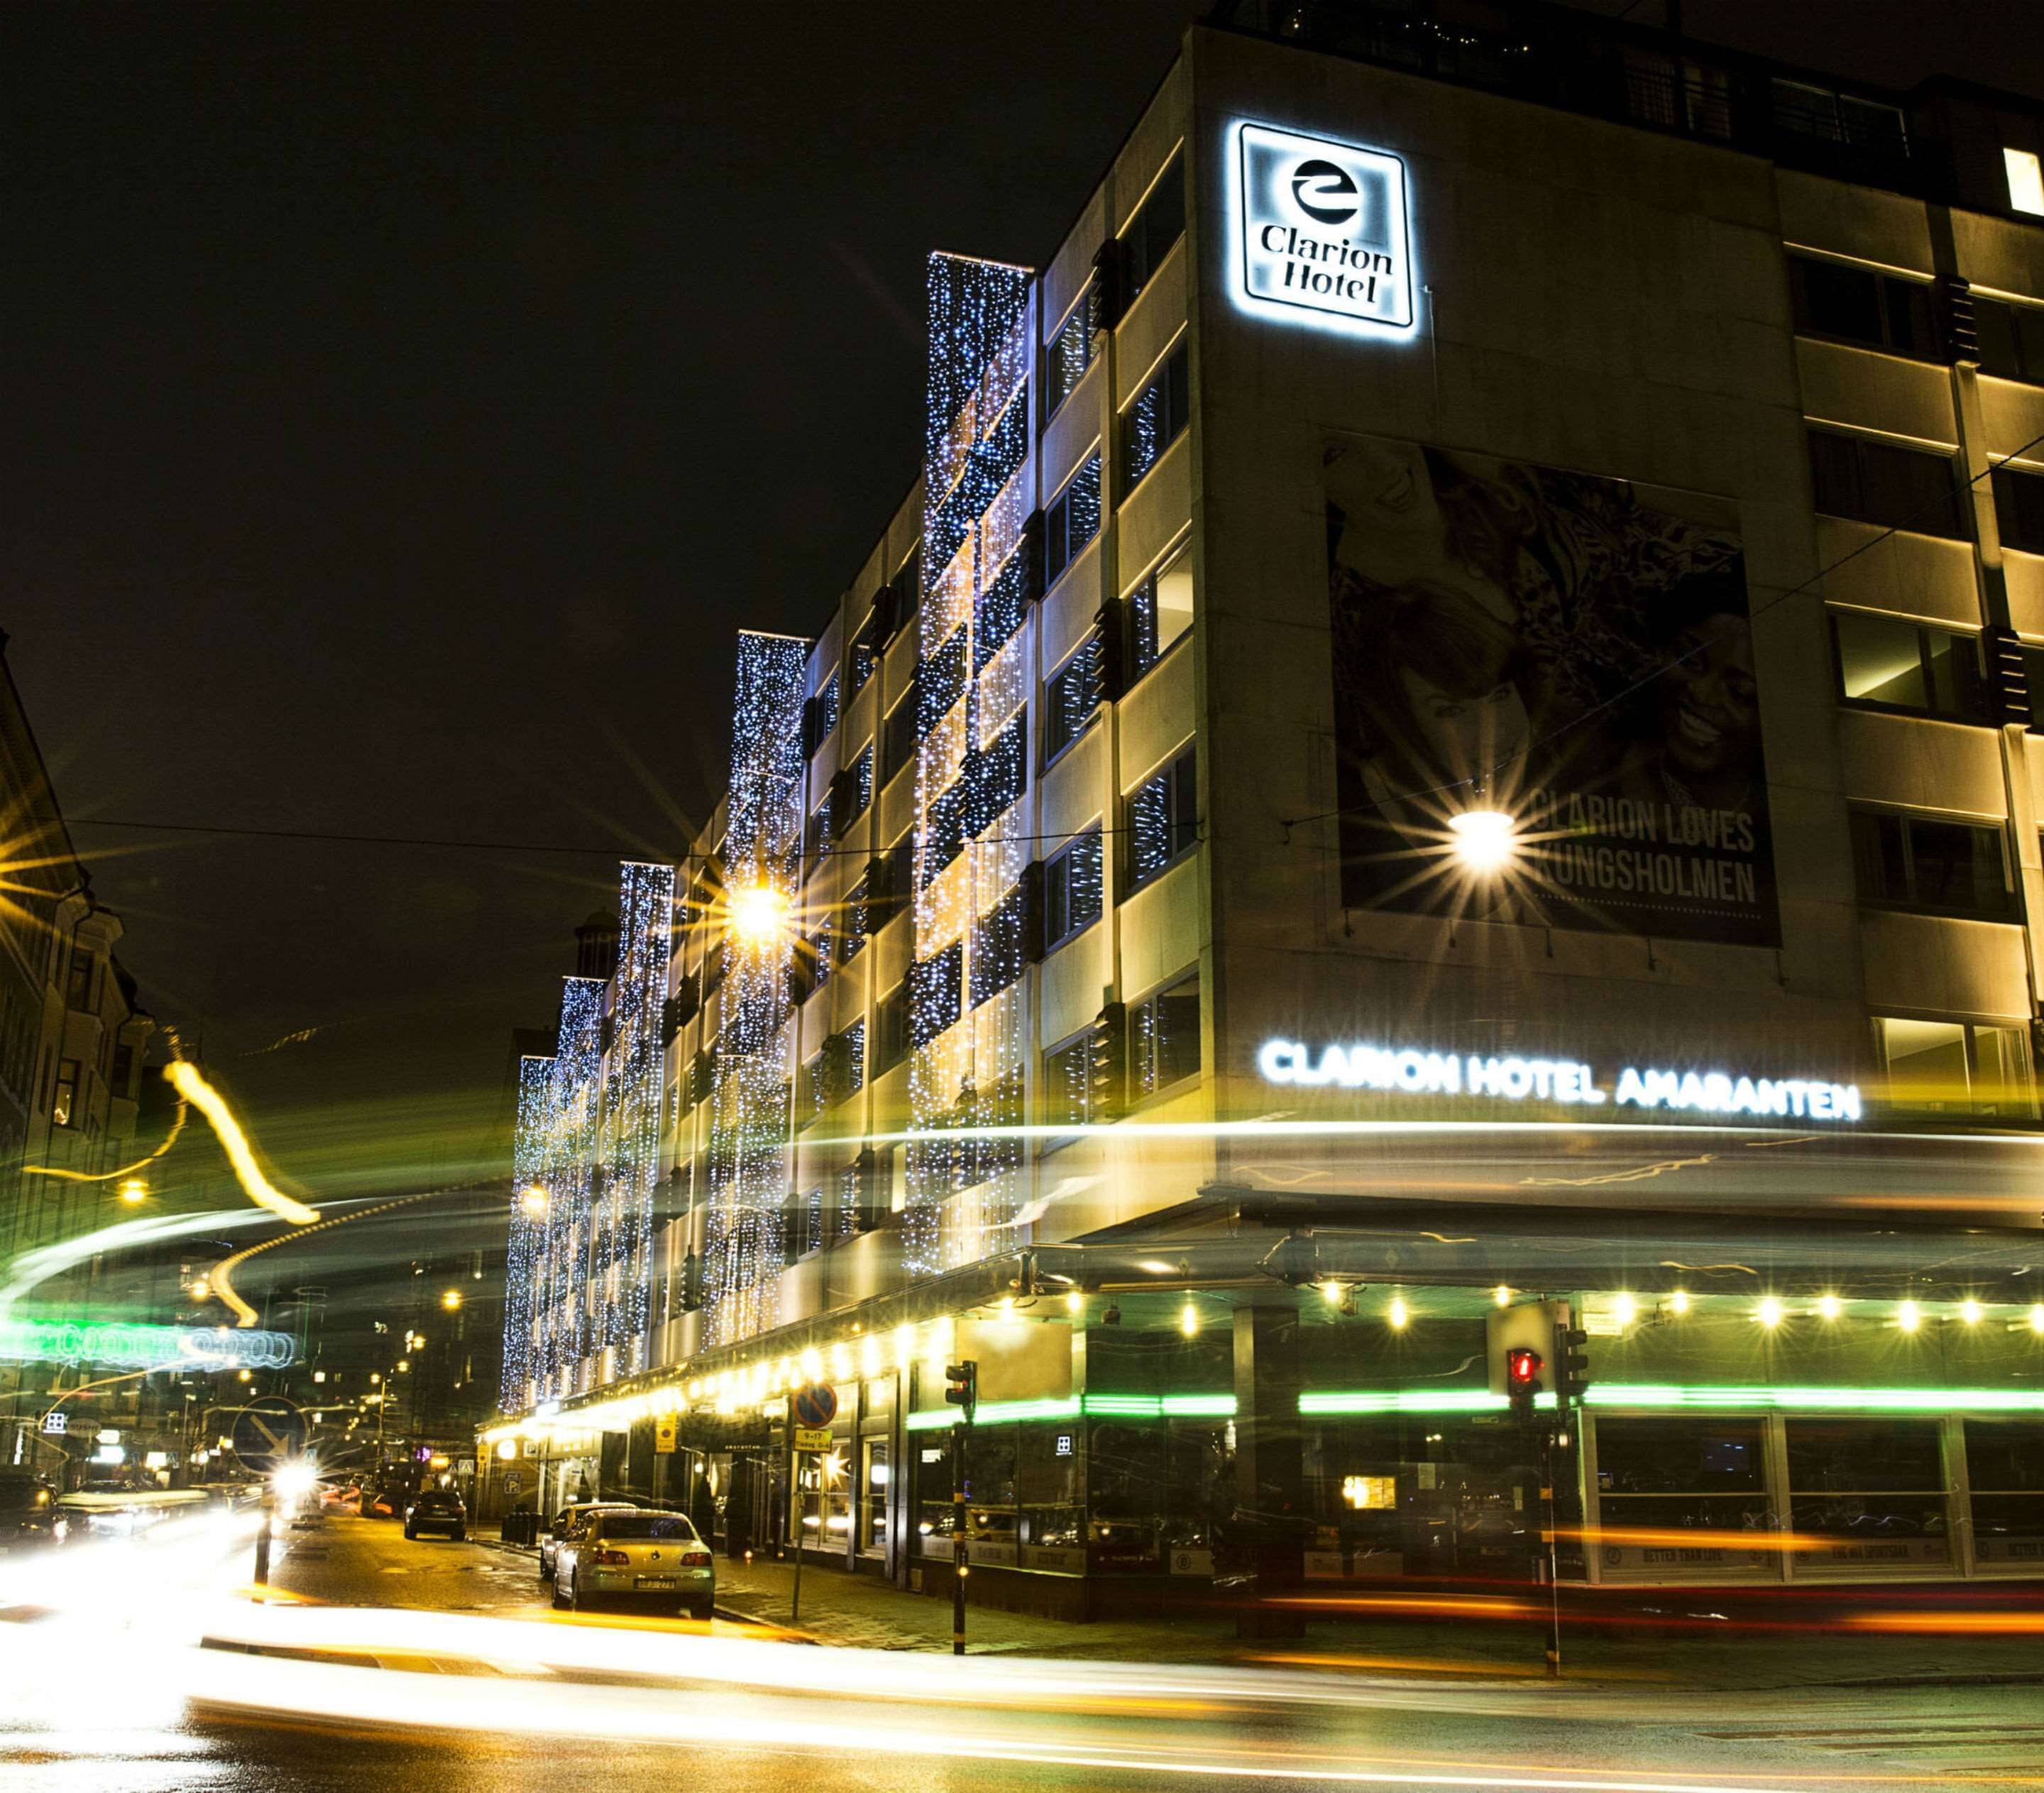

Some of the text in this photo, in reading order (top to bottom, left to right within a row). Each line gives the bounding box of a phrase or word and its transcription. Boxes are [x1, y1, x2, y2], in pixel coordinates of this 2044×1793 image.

[1261, 225, 1393, 275] Clarion
[1284, 261, 1375, 303] Hotel
[1529, 787, 1755, 852] CLARION LOVES
[1534, 842, 1757, 903] KUNGSHOLMEN
[1258, 1040, 1861, 1121] CLARION HOTEL AMARANTEN
